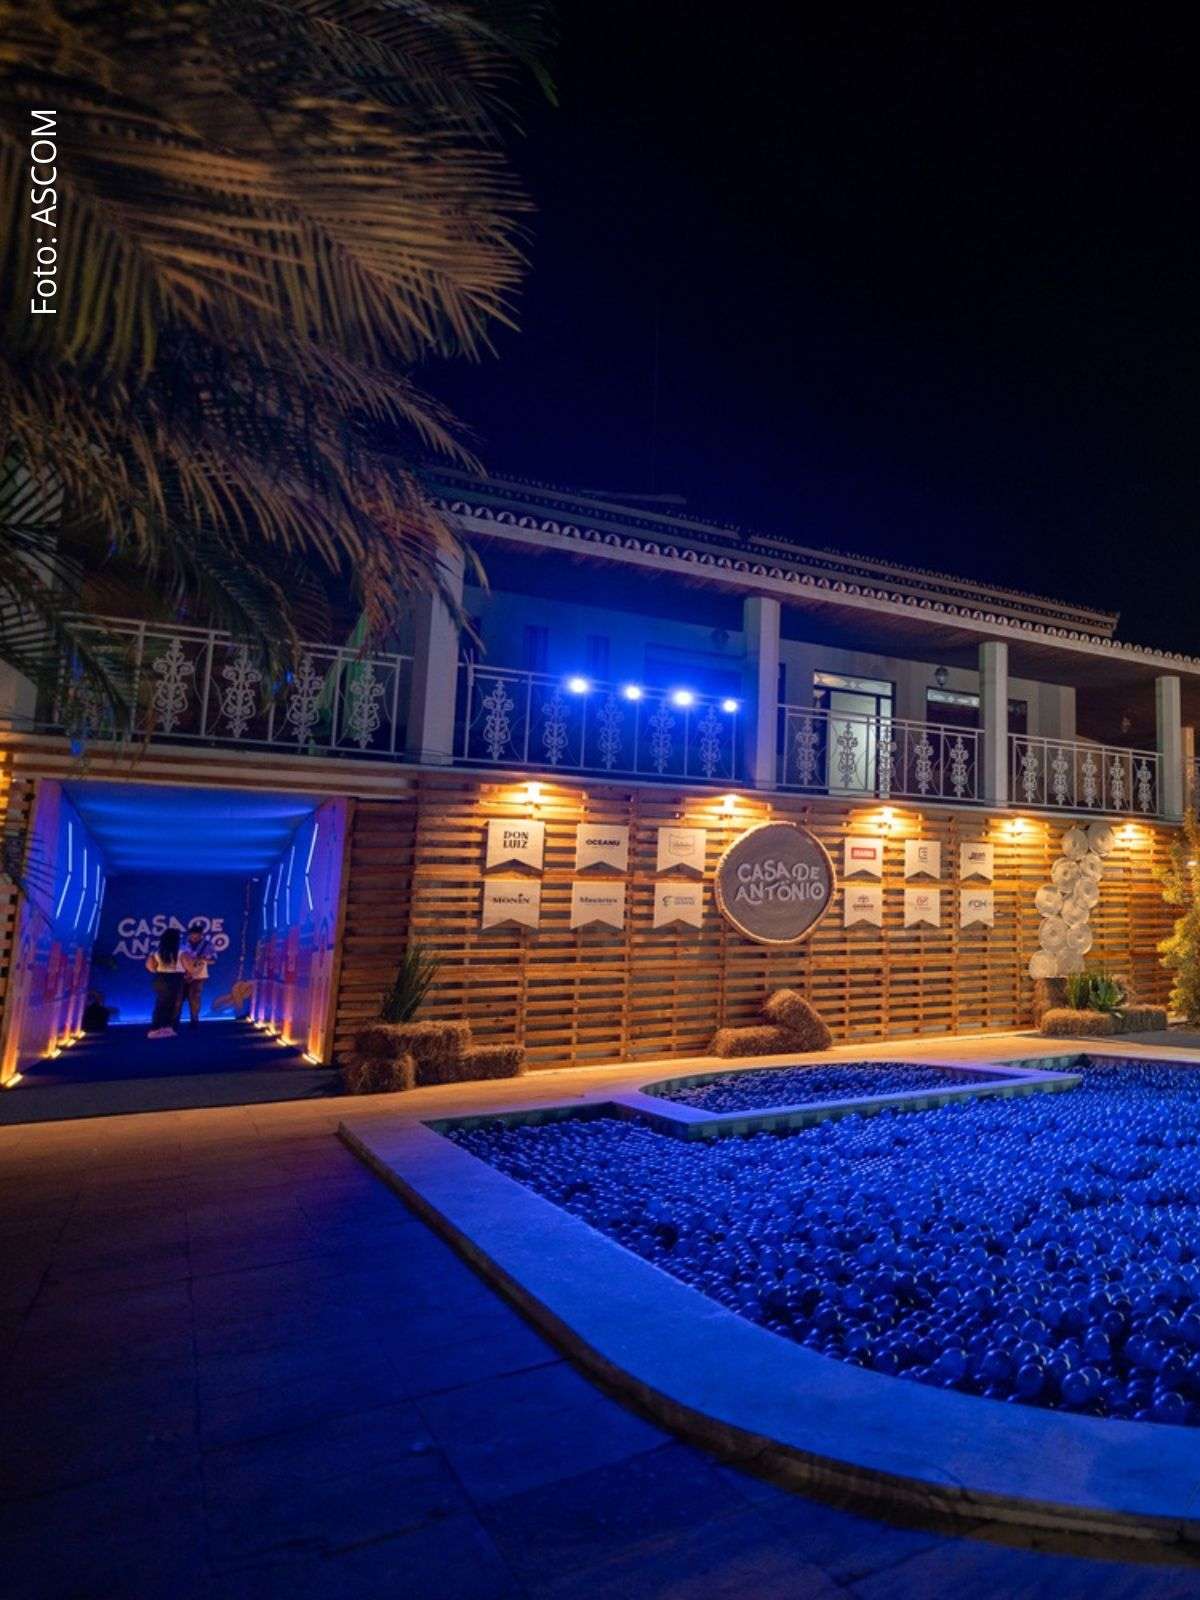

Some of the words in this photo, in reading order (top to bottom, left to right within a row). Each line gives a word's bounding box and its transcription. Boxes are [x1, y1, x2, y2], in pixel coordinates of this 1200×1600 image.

[503, 830, 528, 840] DON
[503, 839, 528, 849] LUIZ
[737, 860, 791, 881] CASA
[792, 863, 820, 881] DE
[118, 915, 186, 938] CASA
